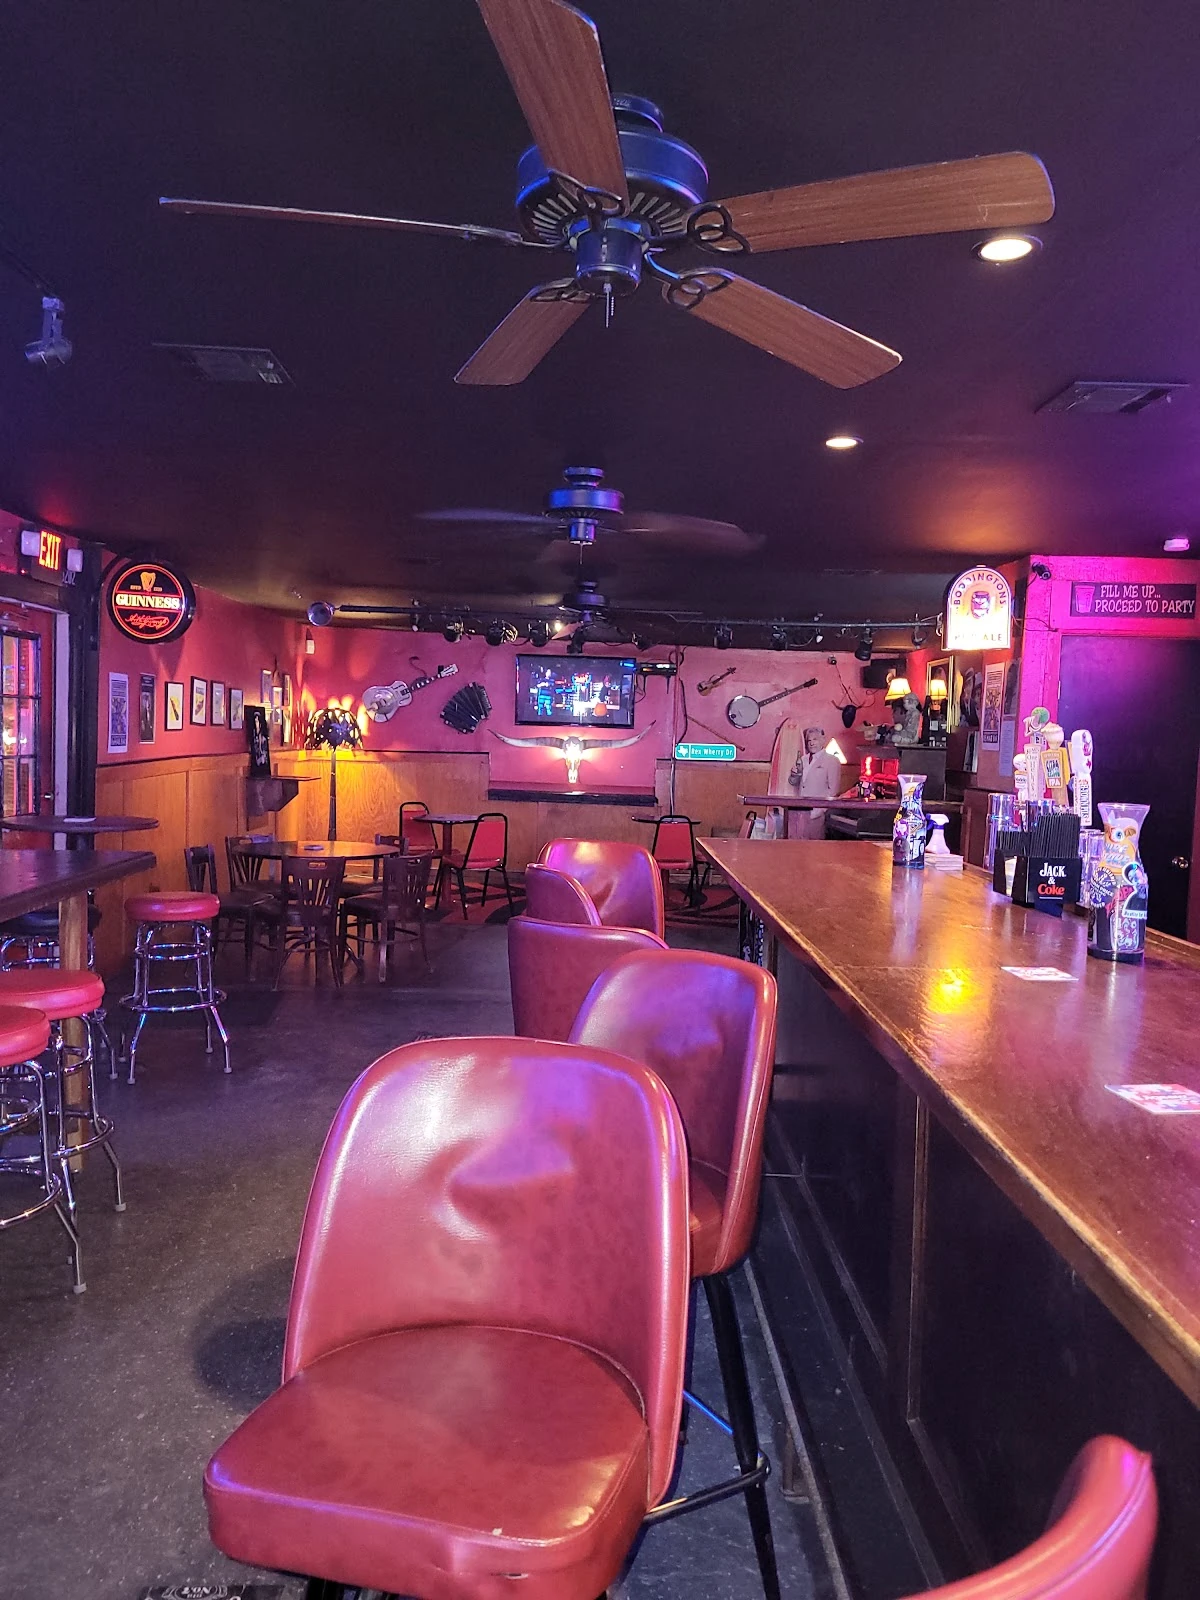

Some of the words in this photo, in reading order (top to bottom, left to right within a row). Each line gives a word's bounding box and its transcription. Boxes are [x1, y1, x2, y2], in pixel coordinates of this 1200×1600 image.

[39, 530, 61, 571] EXIT
[1100, 584, 1120, 598] FILL
[1123, 585, 1138, 599] ME
[1141, 585, 1161, 599] UP...
[115, 593, 180, 610] GUINNESS
[1094, 599, 1142, 613] PROCEED
[1145, 600, 1159, 613] TO
[1161, 600, 1195, 614] PARTY
[703, 748, 724, 758] Wherry
[1039, 862, 1066, 877] JACK
[1047, 876, 1056, 885] &
[1037, 883, 1065, 895] Coke
